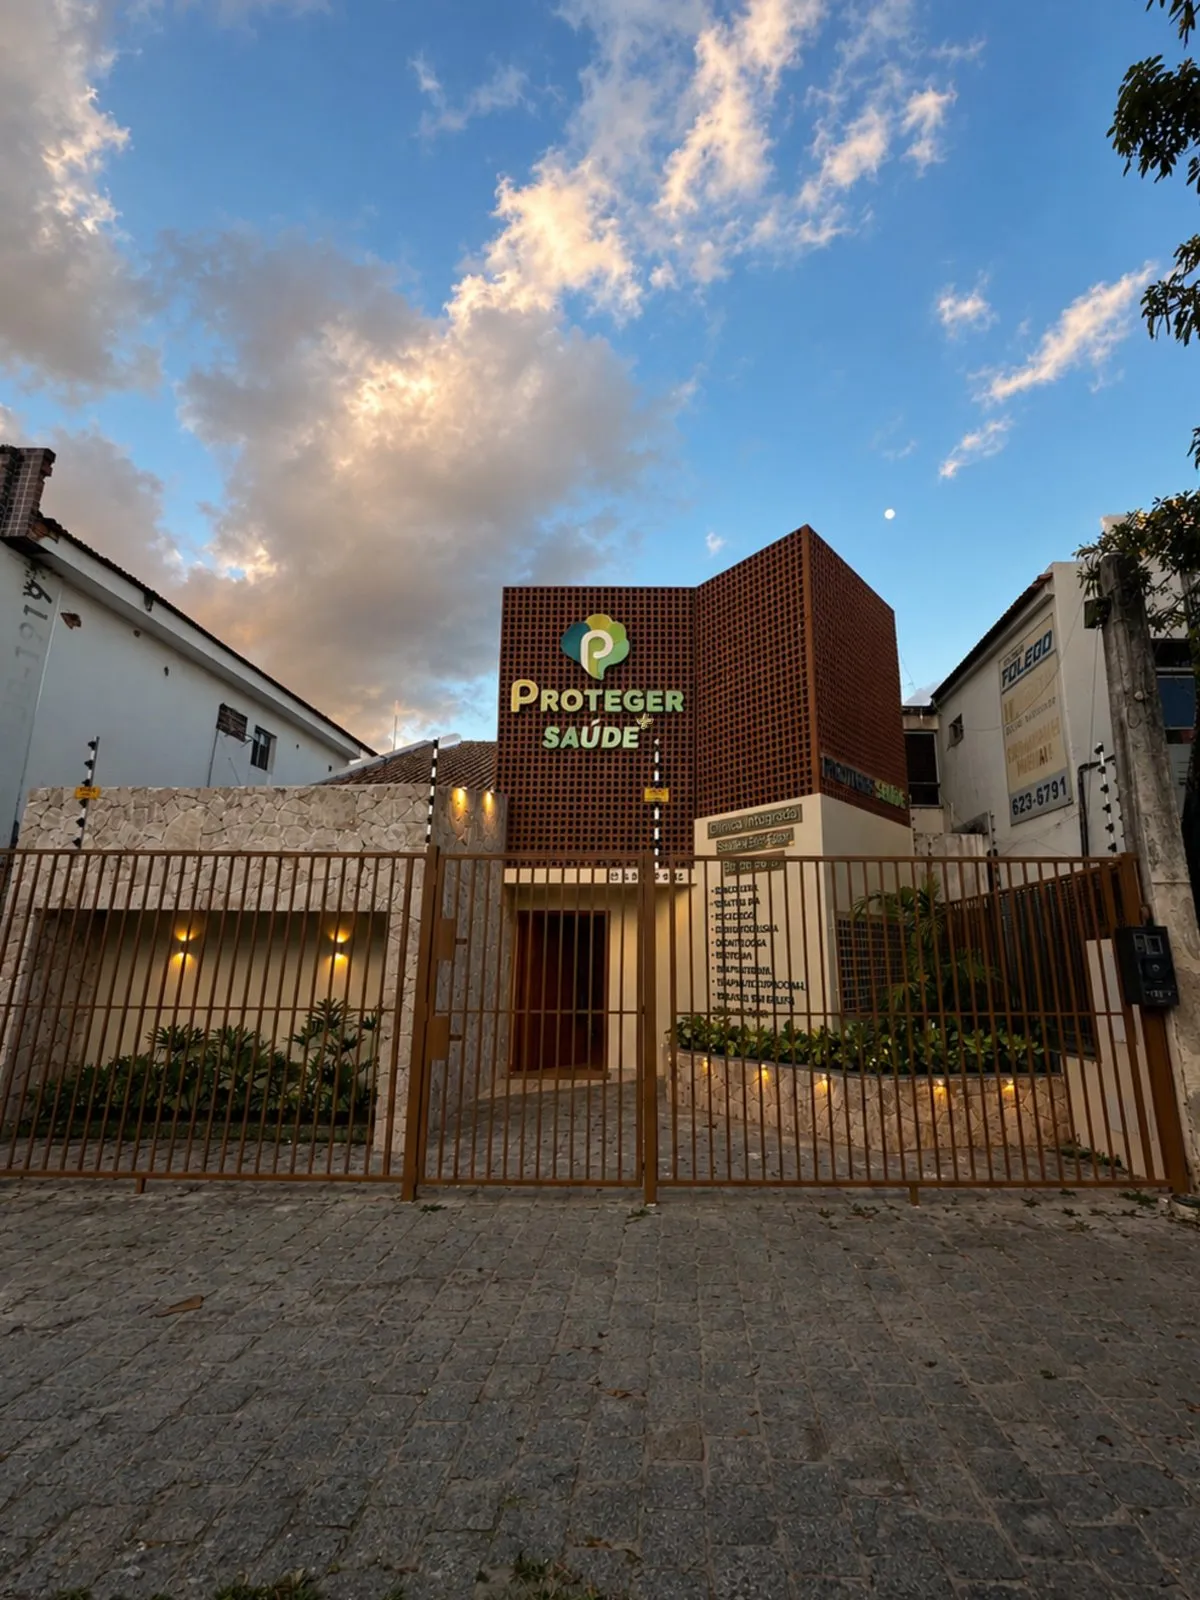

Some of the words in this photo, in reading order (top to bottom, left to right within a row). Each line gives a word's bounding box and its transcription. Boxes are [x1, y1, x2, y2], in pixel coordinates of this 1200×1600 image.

[510, 678, 685, 713] PROTEGER
[542, 718, 640, 749] SAÚDE
[1011, 775, 1067, 816] 623-6791
